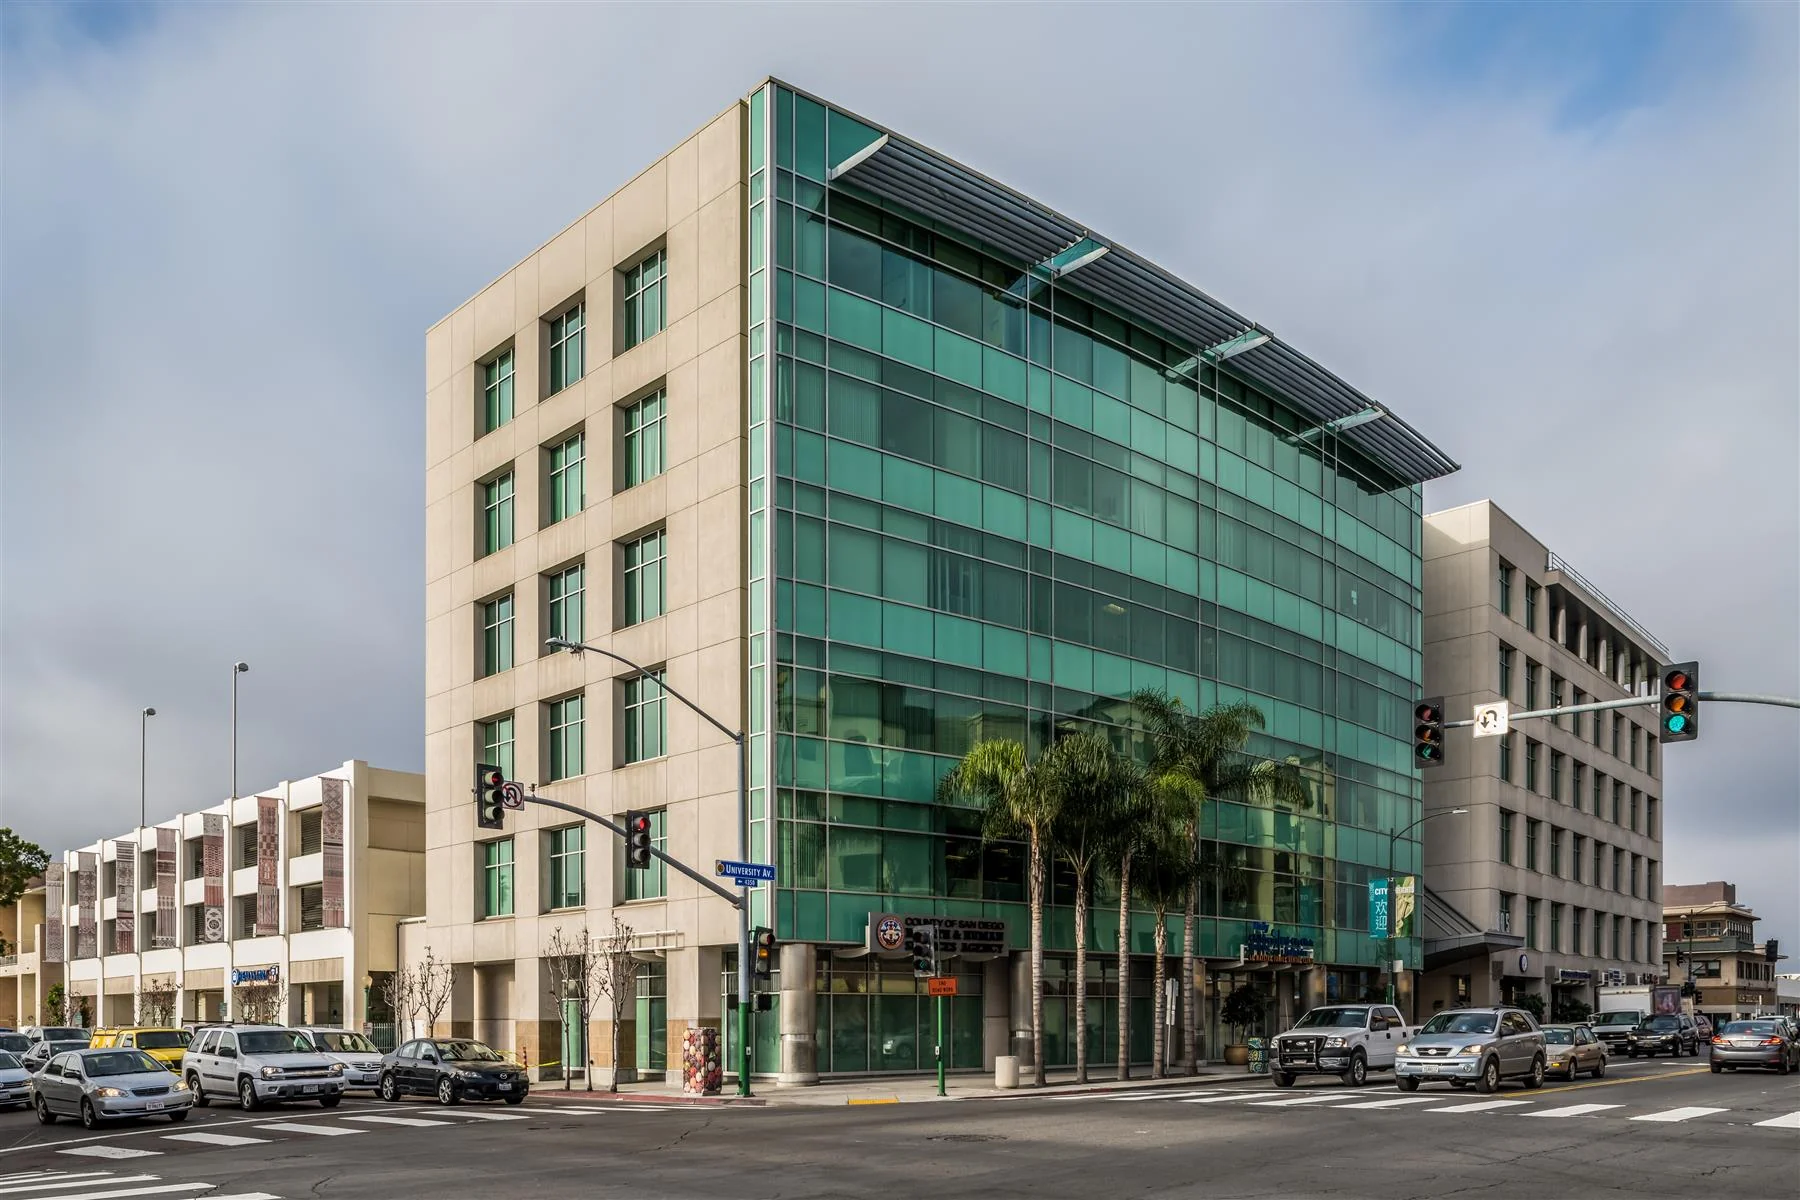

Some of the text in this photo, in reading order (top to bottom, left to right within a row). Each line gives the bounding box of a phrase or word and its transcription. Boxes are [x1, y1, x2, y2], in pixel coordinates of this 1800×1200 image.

[726, 864, 761, 876] UNIVERSITY
[1375, 887, 1388, 895] CITY
[905, 917, 1005, 930] COUNTY OF SAN DIEGO
